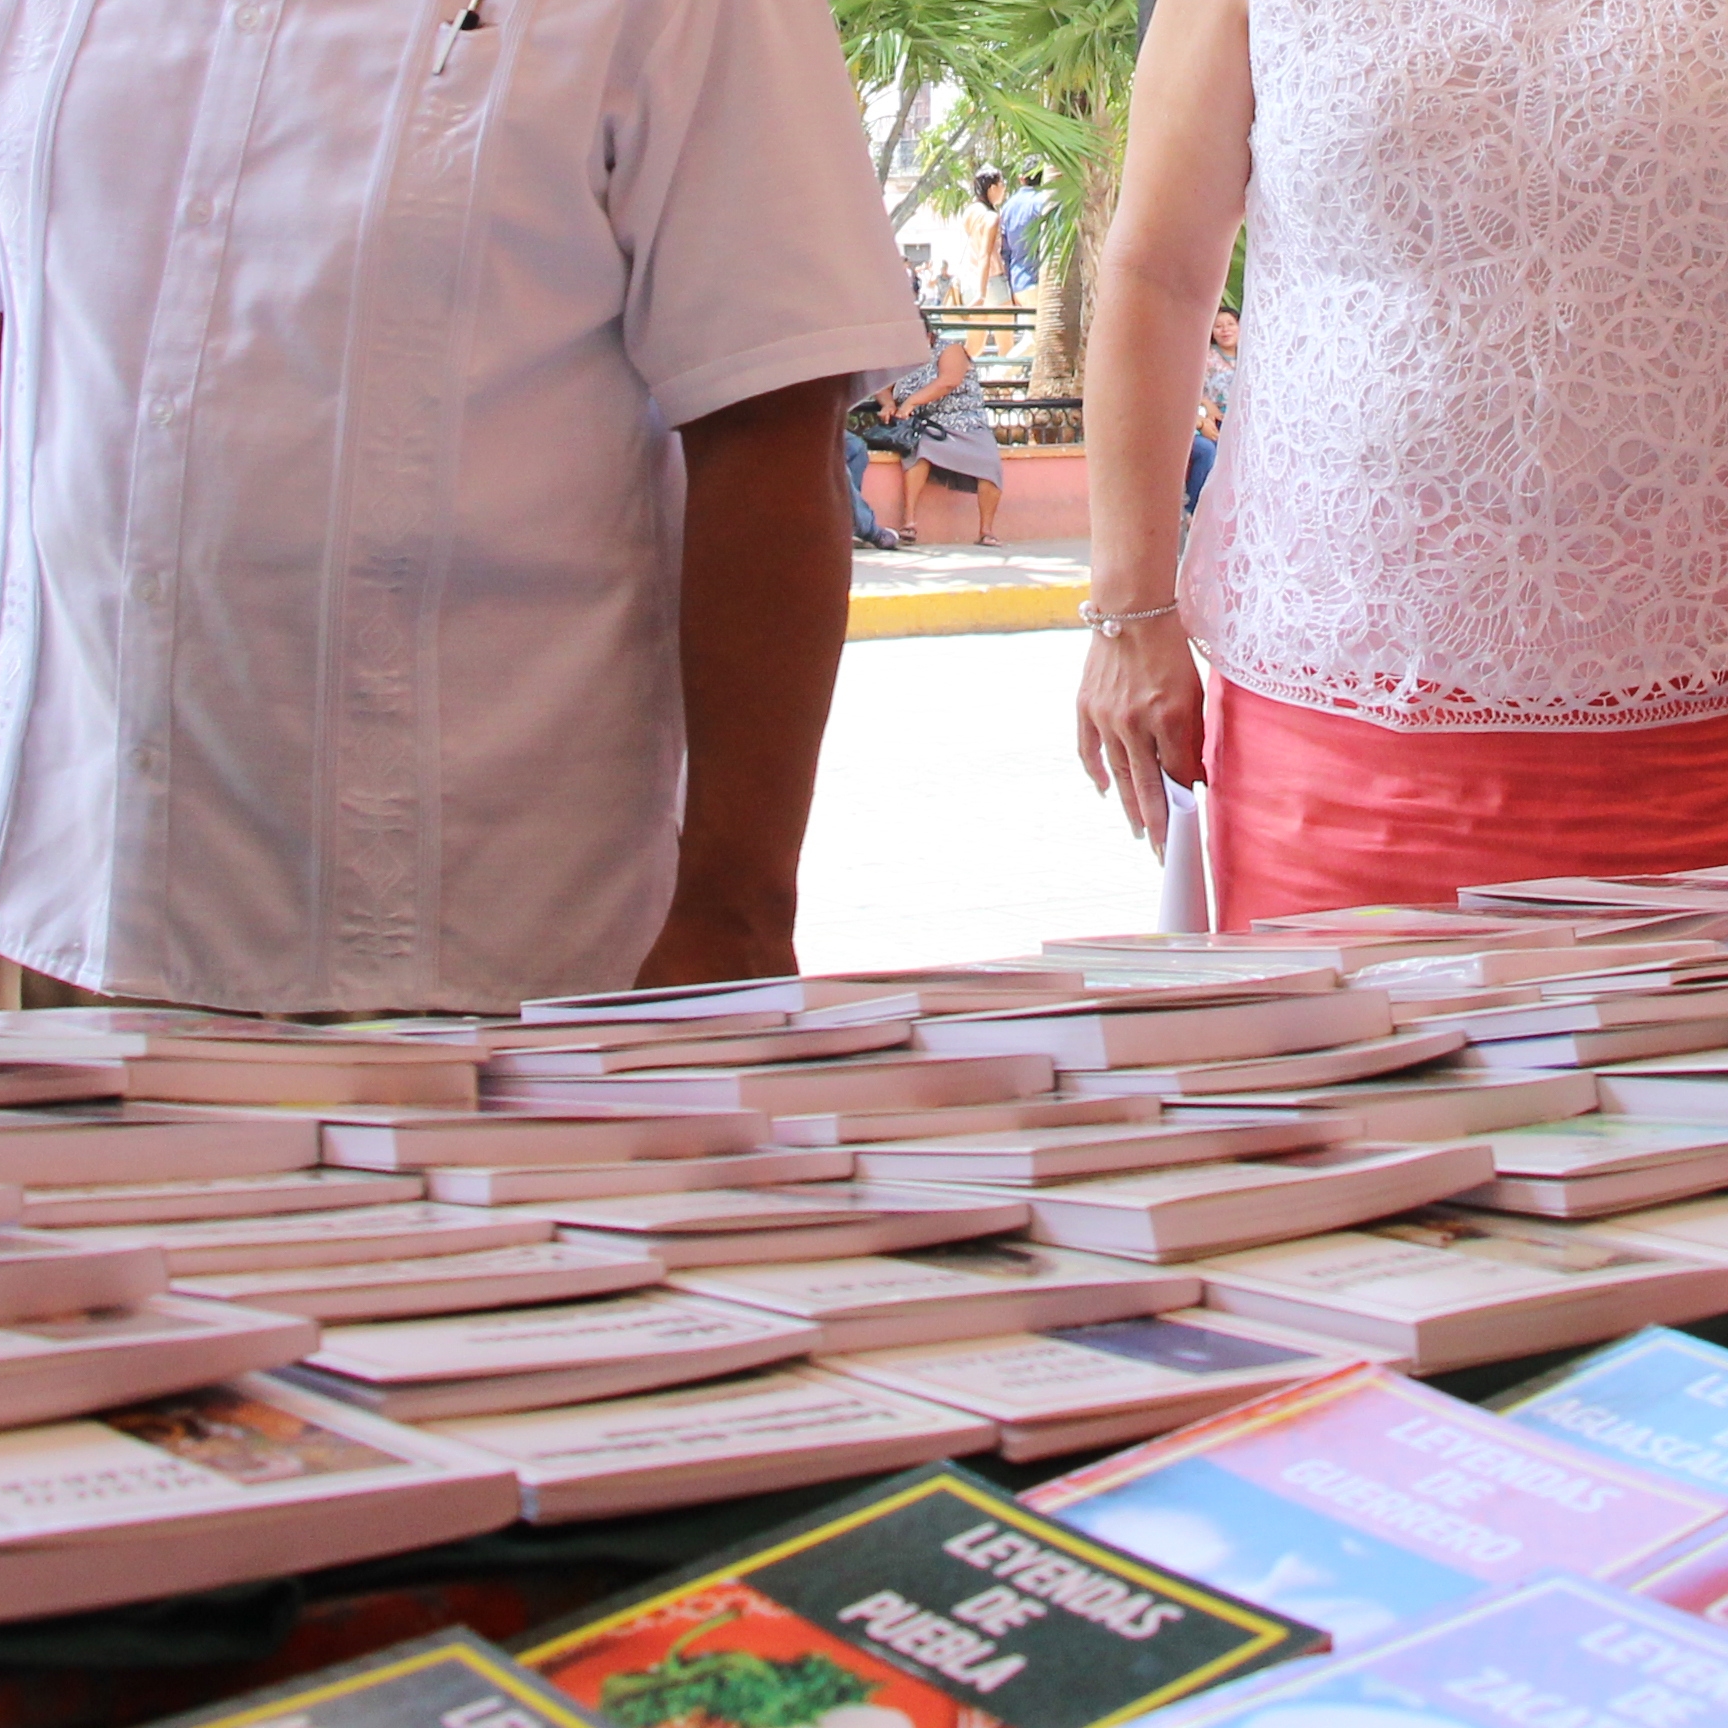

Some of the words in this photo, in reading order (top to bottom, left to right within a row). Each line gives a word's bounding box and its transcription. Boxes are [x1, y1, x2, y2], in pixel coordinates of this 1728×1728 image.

[1280, 1457, 1523, 1565] GUERRERO
[1387, 1416, 1628, 1516] LEYENDAS
[1412, 1468, 1495, 1510] DE
[942, 1522, 1186, 1642] LEYENDAS
[950, 1585, 1048, 1639] DE
[835, 1590, 1028, 1693] PUEBLA
[1608, 1680, 1711, 1728] DE
